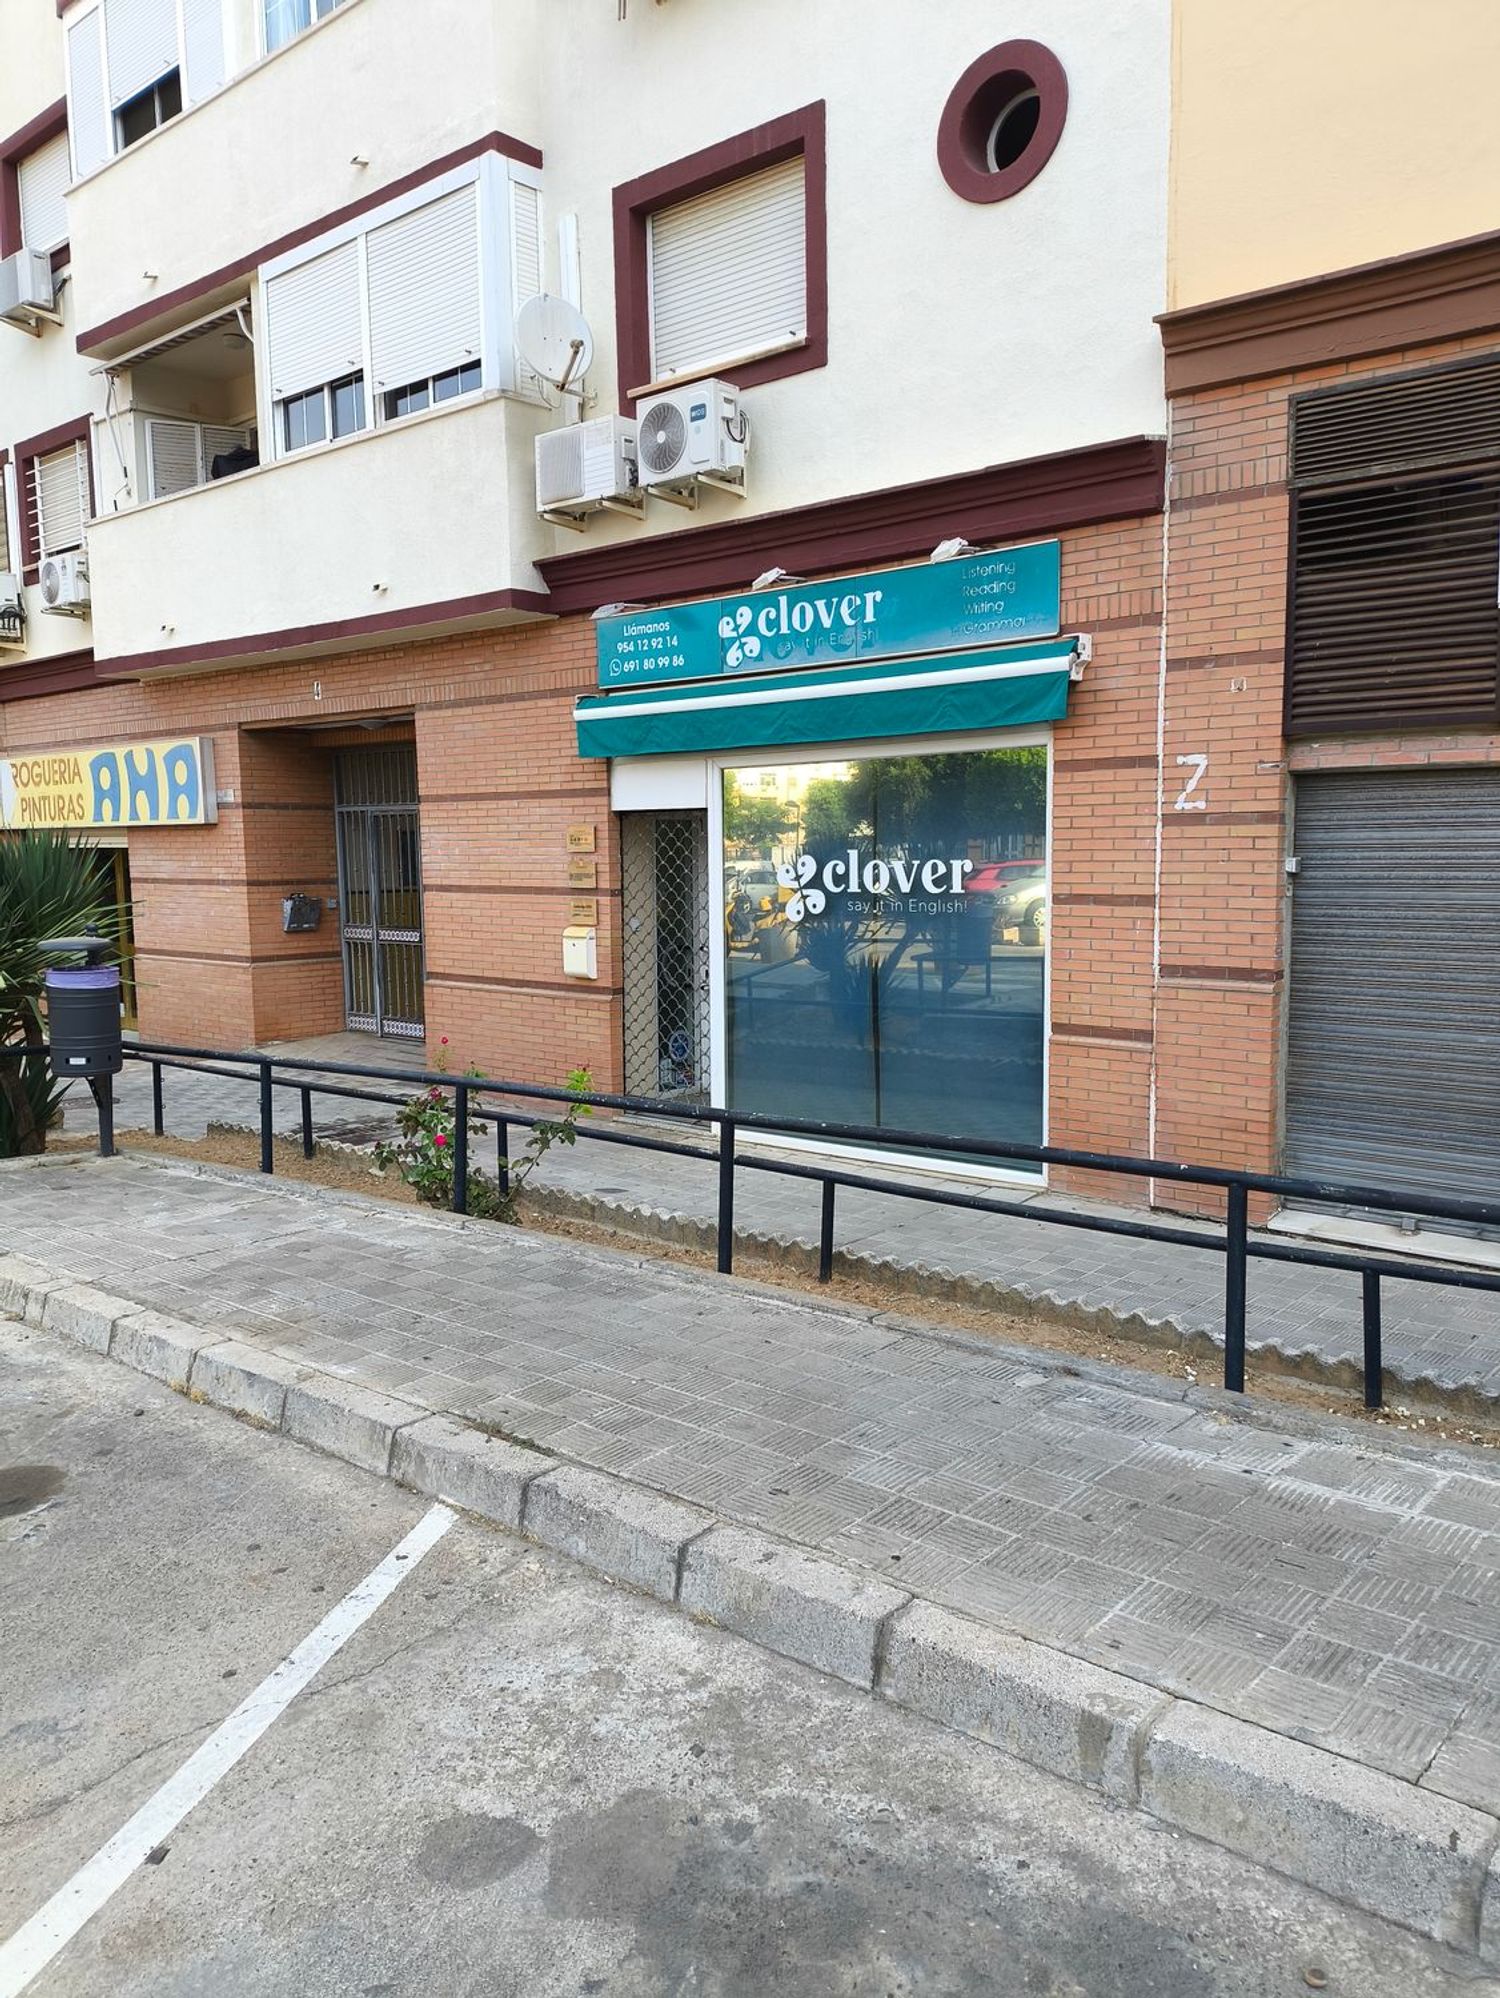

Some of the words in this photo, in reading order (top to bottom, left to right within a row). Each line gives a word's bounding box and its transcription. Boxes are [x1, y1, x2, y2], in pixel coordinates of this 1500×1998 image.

[962, 562, 1015, 579] Listening
[963, 581, 1015, 597] Reading
[757, 590, 882, 637] clover
[623, 621, 670, 636] Llámanos
[963, 616, 1026, 634] Grammar
[617, 640, 634, 653] 954
[637, 639, 649, 651] 12
[651, 637, 663, 649] 92
[666, 635, 678, 647] 14
[623, 660, 639, 672] 691
[643, 658, 655, 670] 80
[657, 656, 670, 668] 99
[672, 654, 684, 667] 86
[20, 792, 85, 822] PINTURAS
[822, 849, 974, 894] clover
[847, 900, 870, 914] say
[890, 899, 903, 912] in
[908, 898, 967, 916] English!
